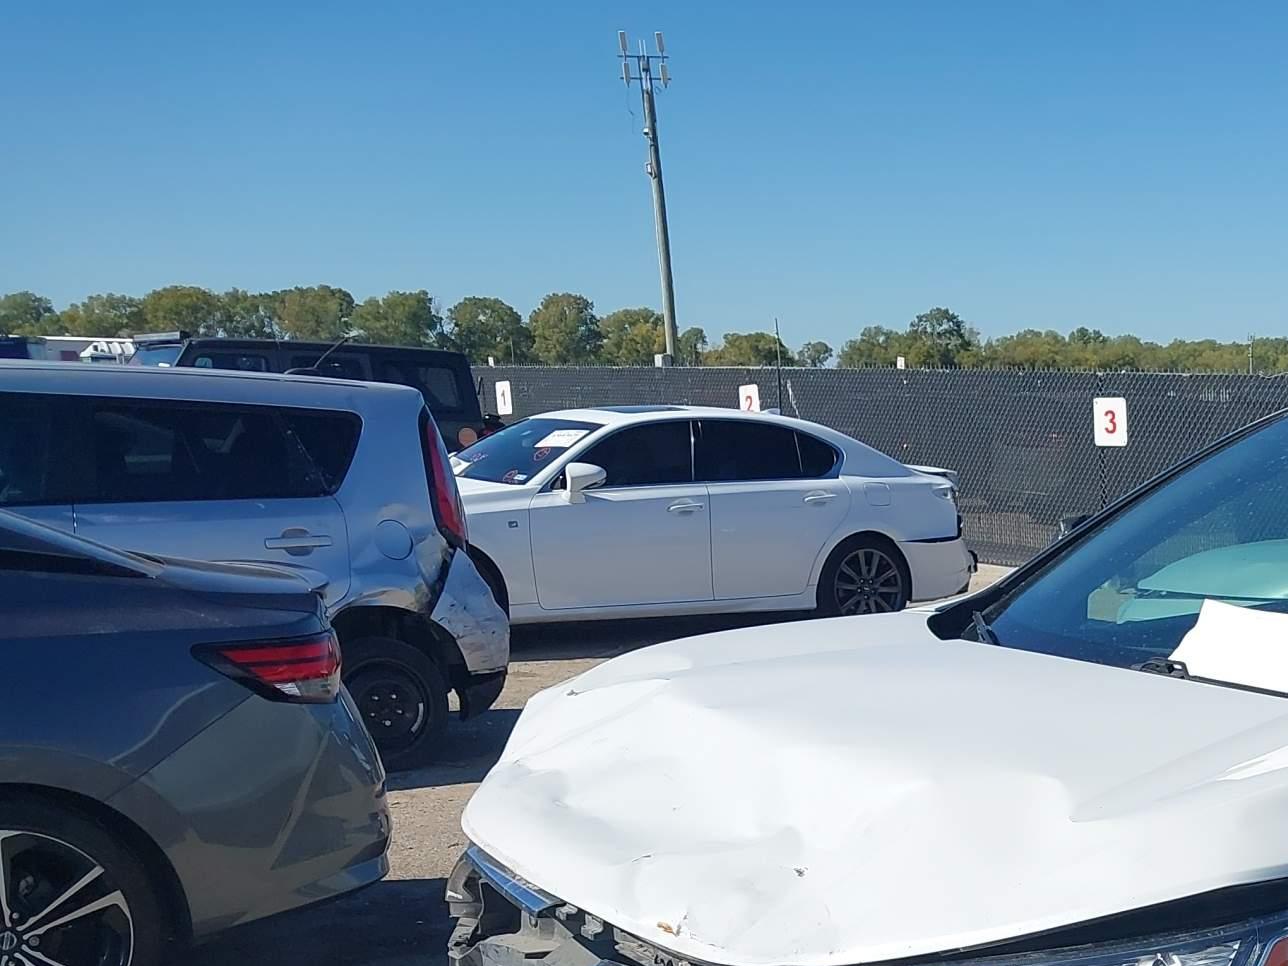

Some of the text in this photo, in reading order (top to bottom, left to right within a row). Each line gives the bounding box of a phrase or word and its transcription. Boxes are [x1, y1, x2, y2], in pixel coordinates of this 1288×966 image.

[500, 389, 507, 407] 1
[745, 395, 753, 411] 2
[1104, 409, 1117, 434] 3
